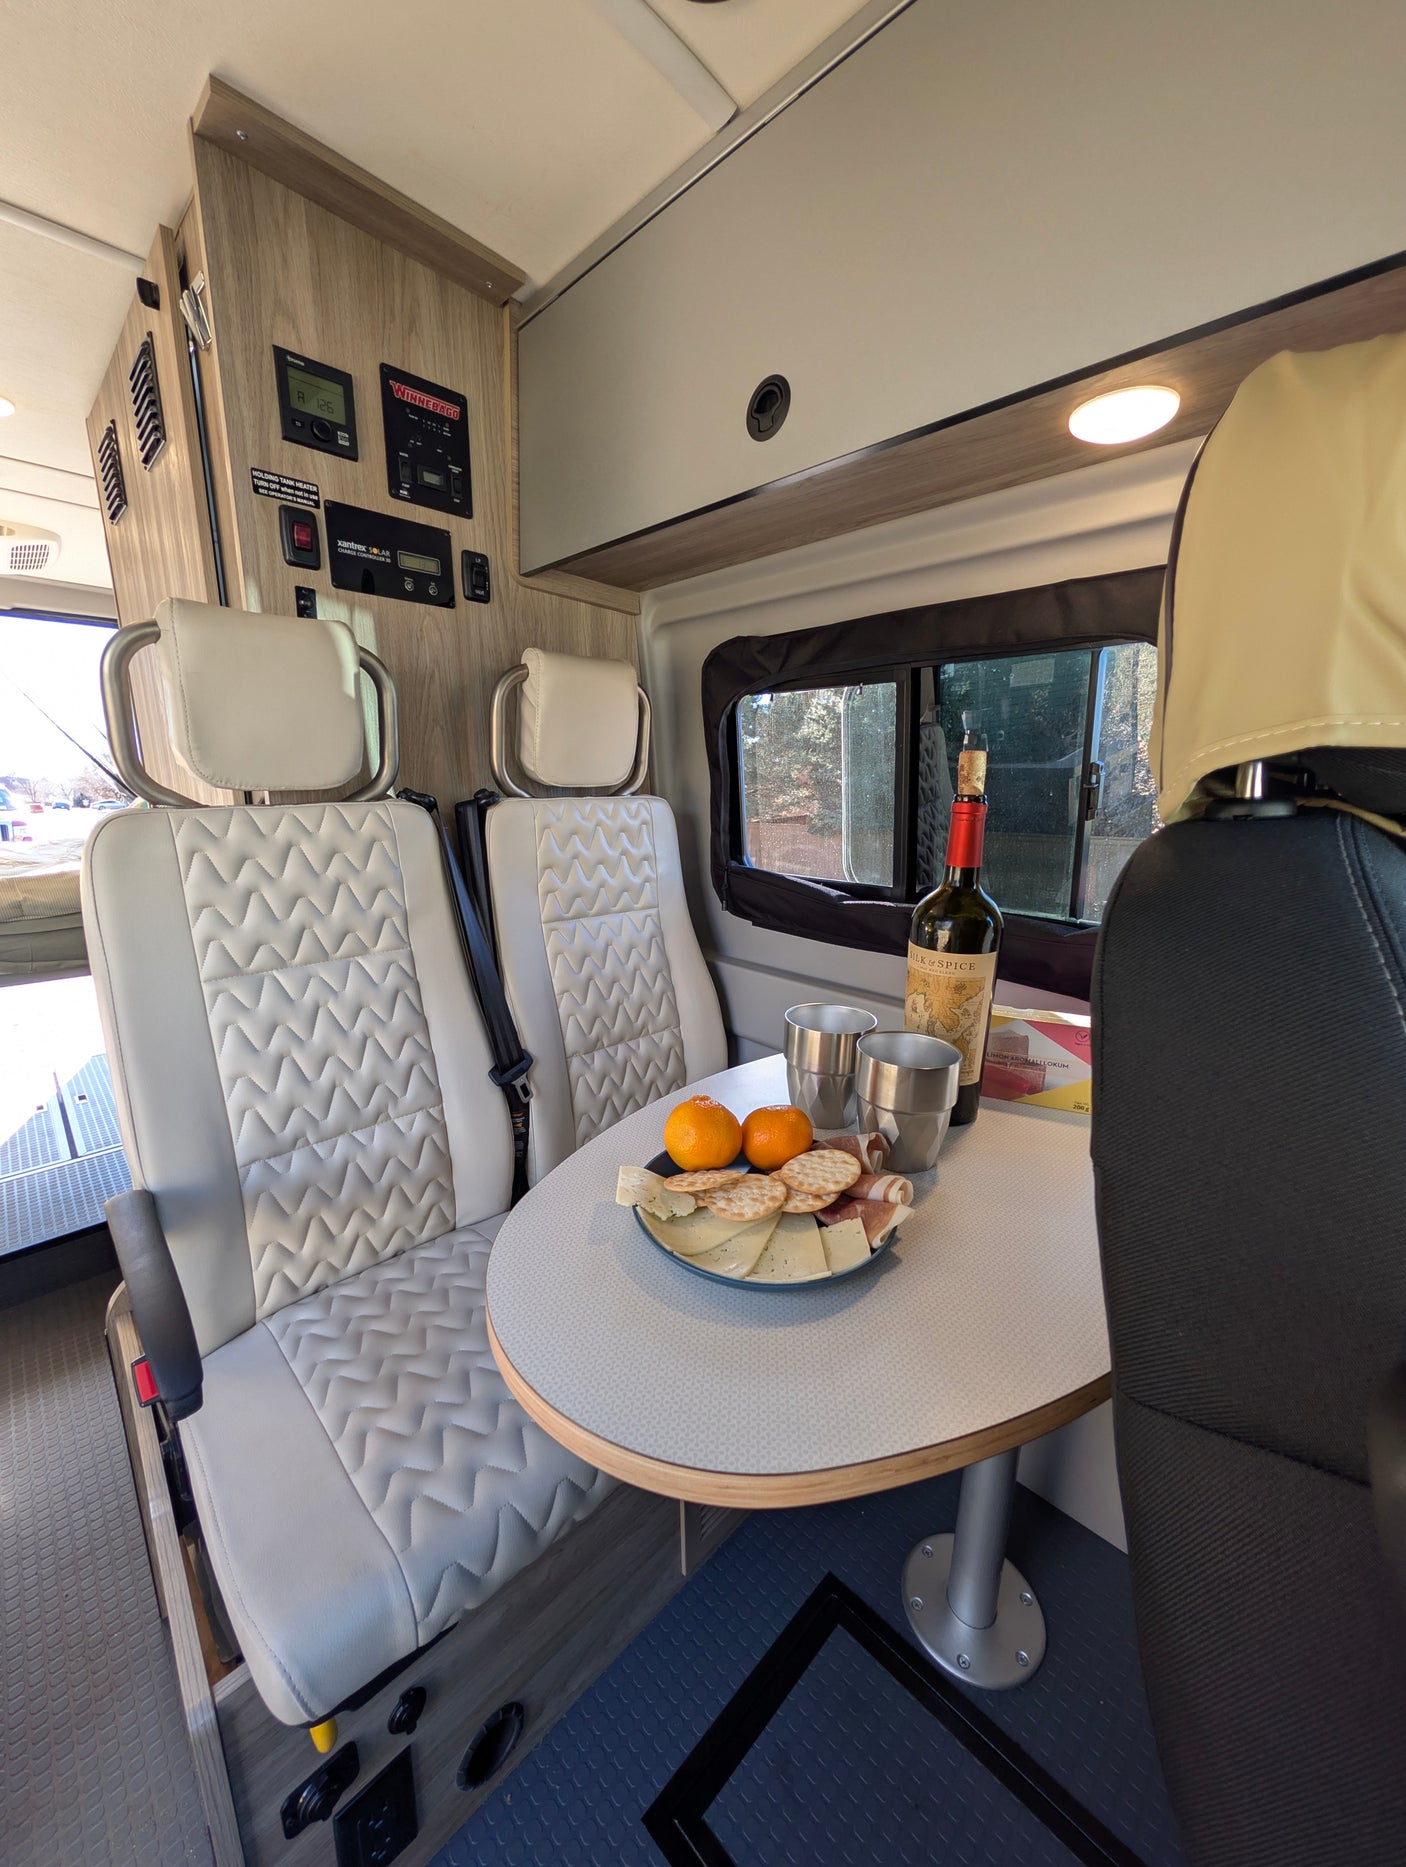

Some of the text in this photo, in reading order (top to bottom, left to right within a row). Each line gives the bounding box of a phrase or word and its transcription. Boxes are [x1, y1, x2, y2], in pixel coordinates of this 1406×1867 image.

[316, 397, 334, 414] 126
[389, 380, 460, 420] WINNEBAGO
[252, 470, 318, 492] HOLDING TANK HEATER
[253, 478, 269, 488] TURN
[269, 482, 280, 490] OFF
[280, 486, 294, 495] when
[294, 489, 303, 497] not
[337, 539, 391, 558] xantrex SOLAR
[337, 547, 357, 556] CHARGE
[356, 551, 386, 562] CONTROLLER
[910, 951, 926, 964] SILK
[928, 959, 936, 967] &
[937, 960, 976, 971] SPICE
[1043, 1061, 1069, 1069] LOKUM
[1072, 1103, 1085, 1111] 200
